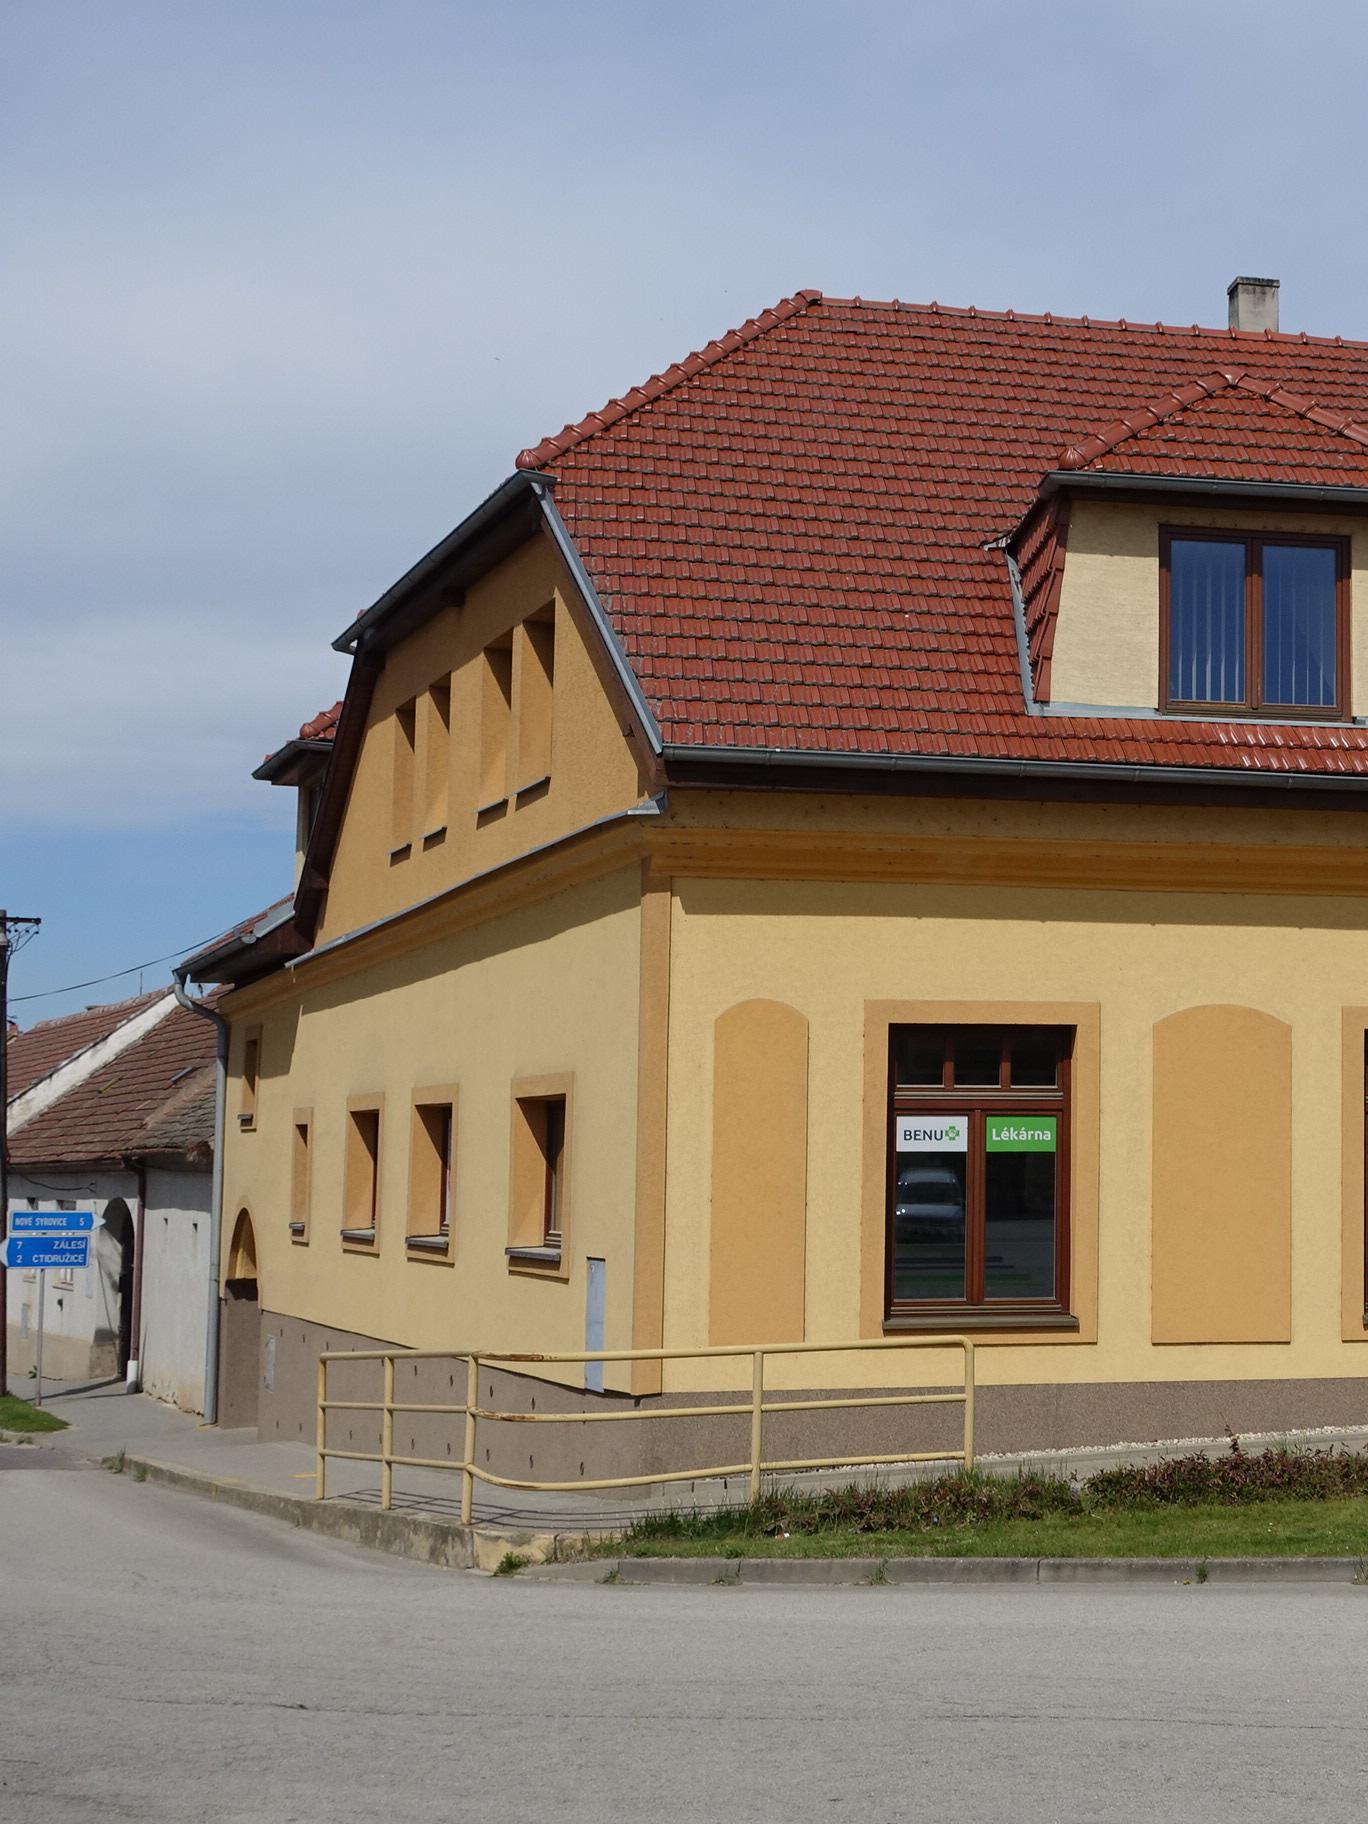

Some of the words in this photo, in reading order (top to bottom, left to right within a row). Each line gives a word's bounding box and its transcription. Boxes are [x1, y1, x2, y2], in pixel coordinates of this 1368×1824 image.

[903, 1129, 943, 1141] BENU
[992, 1127, 1051, 1141] Lékárna
[79, 1217, 85, 1226] 5
[16, 1241, 23, 1249] 7
[16, 1254, 23, 1263] 2
[32, 1253, 85, 1263] CTIDRUŽICE
